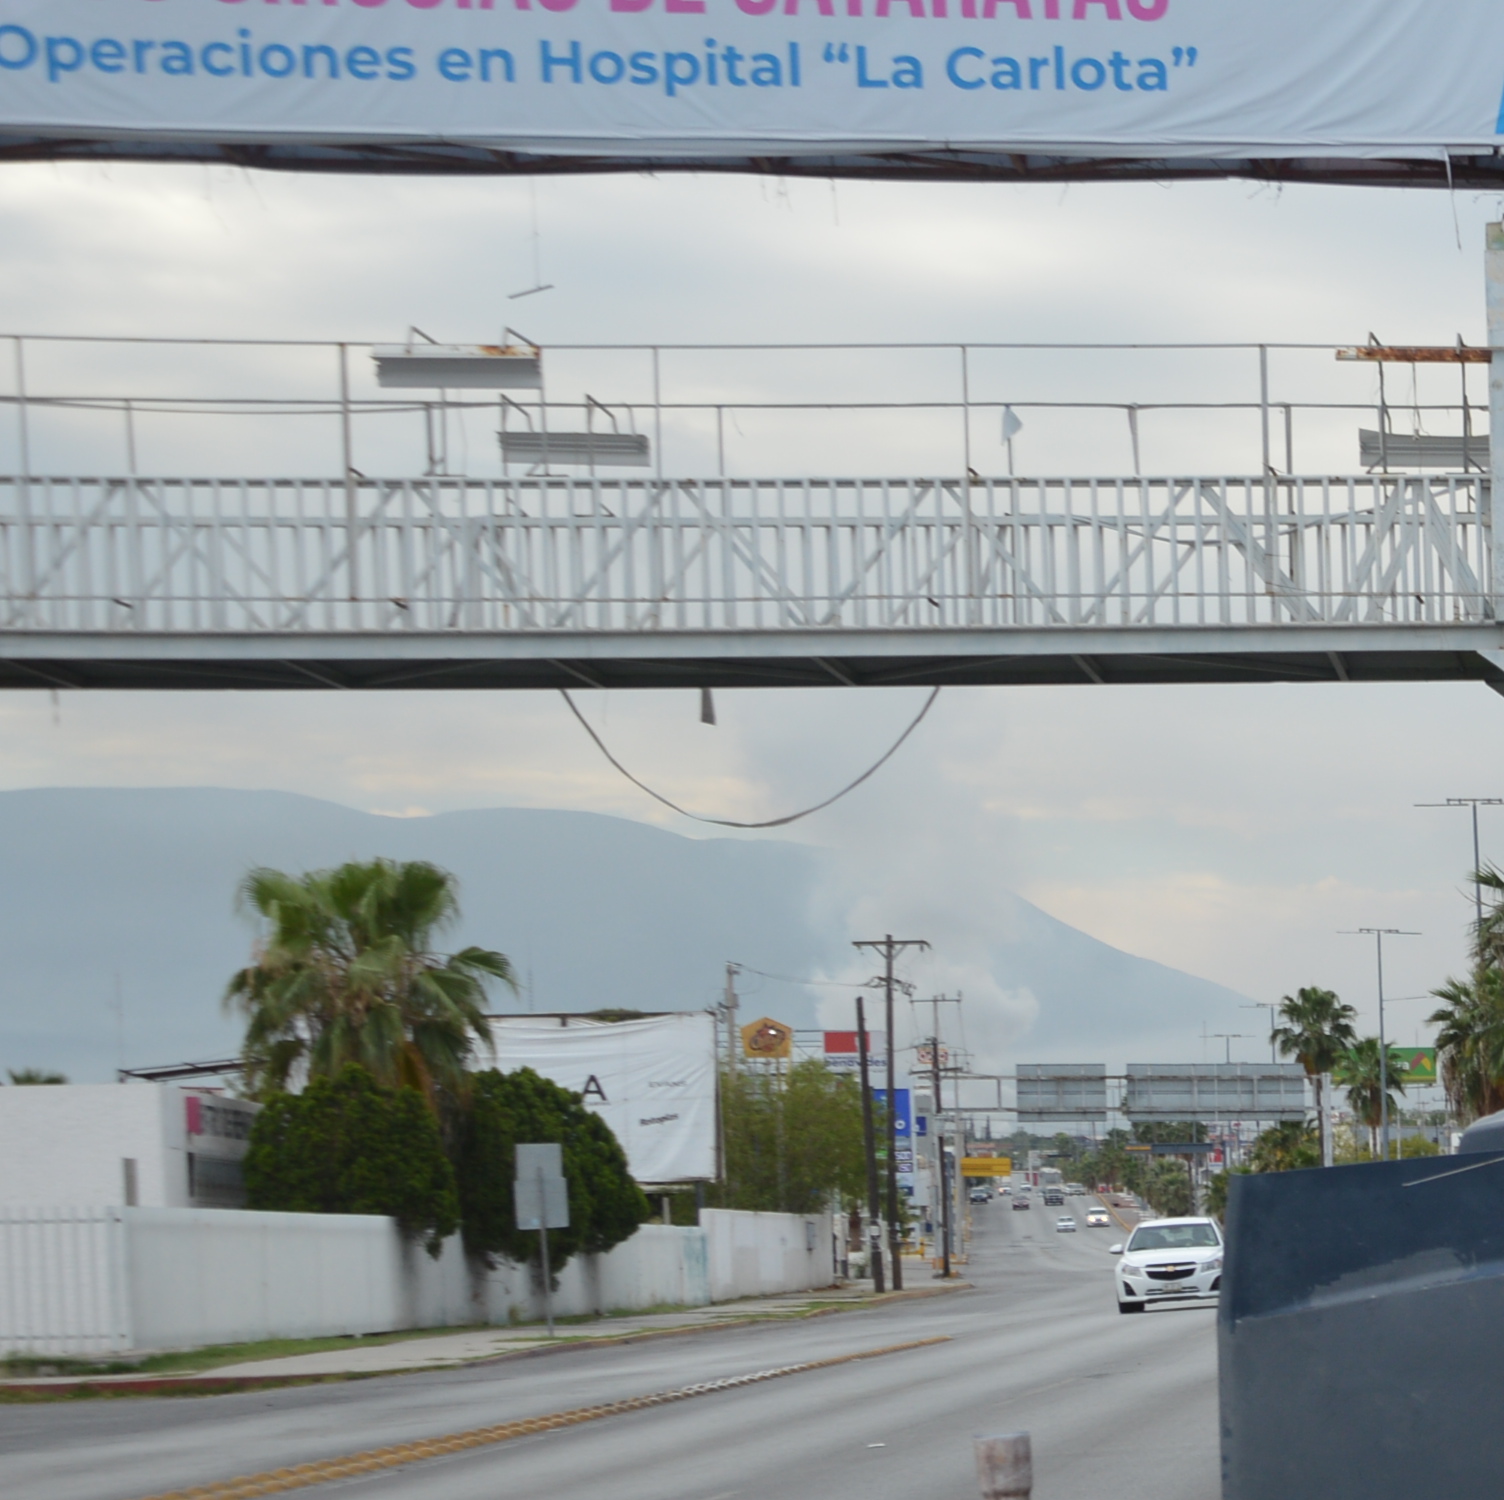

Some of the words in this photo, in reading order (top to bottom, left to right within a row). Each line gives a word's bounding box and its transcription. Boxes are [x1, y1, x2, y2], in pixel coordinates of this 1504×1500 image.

[0, 24, 417, 82] Operaciones
[437, 46, 516, 82] en
[540, 38, 801, 97] Hospital
